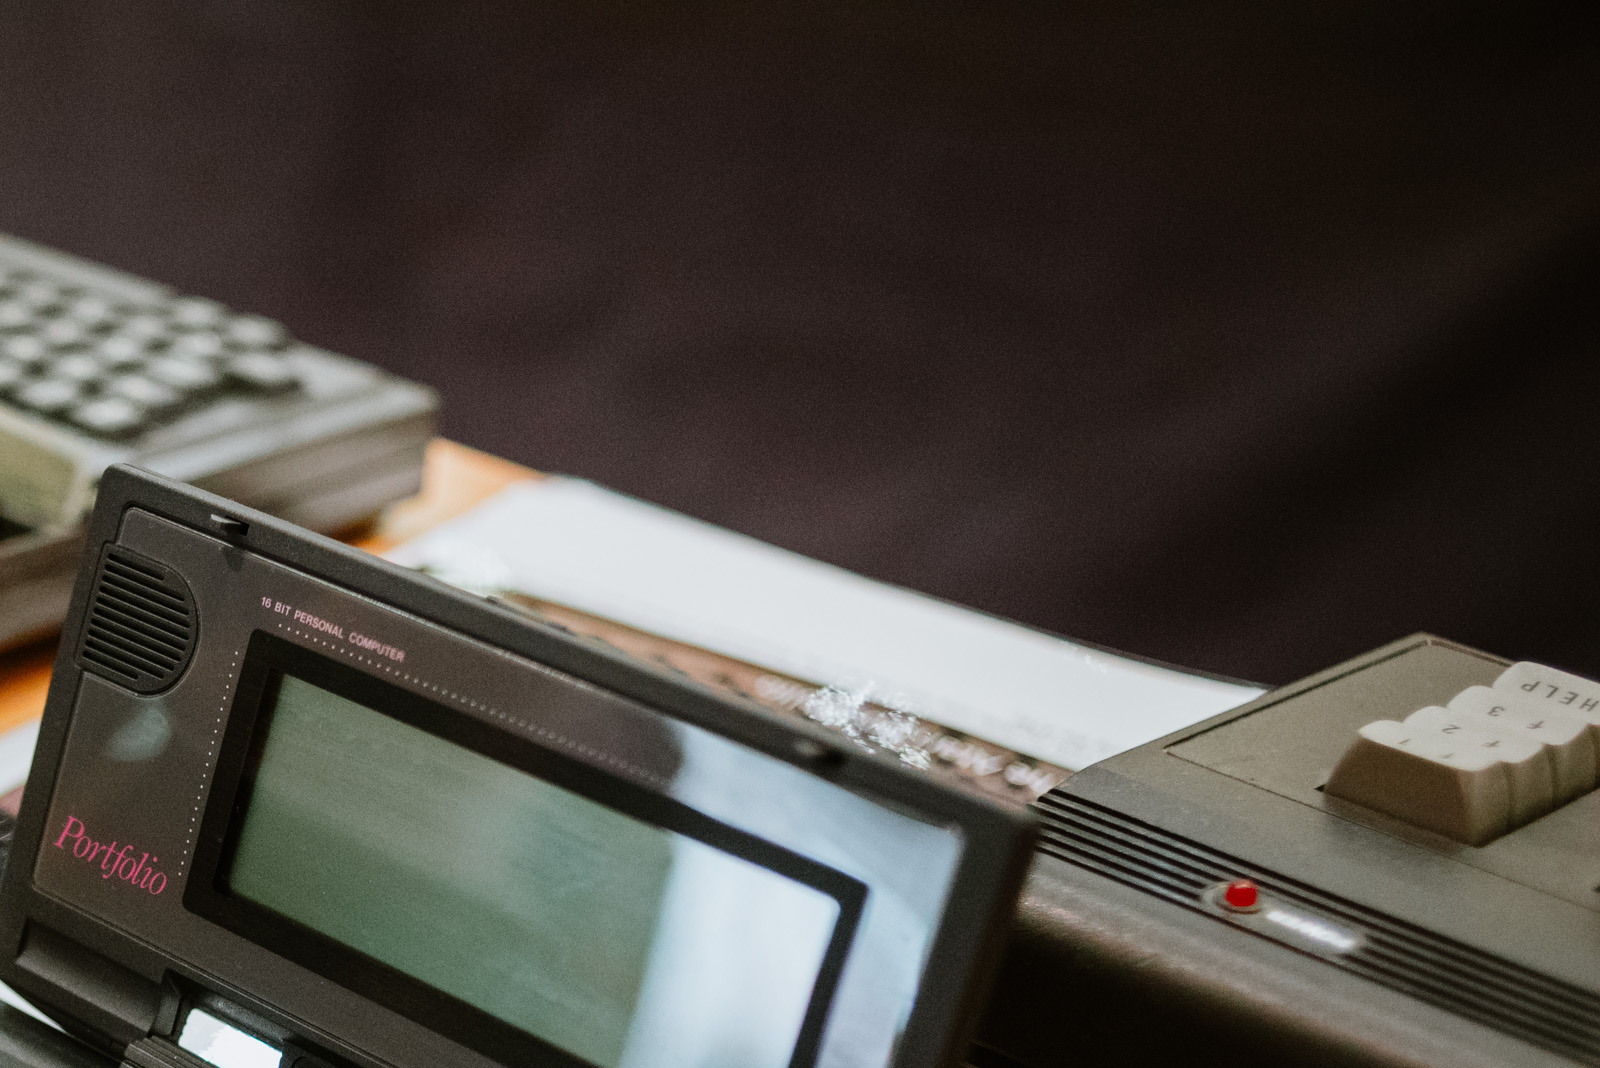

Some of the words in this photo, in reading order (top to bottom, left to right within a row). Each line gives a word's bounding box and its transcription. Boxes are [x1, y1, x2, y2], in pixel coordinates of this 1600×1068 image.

[261, 596, 272, 609] 16
[274, 601, 292, 616] BIT
[293, 609, 344, 639] PERSONAL
[348, 632, 406, 663] COMPUTER
[1488, 705, 1505, 717] 3
[1520, 680, 1600, 713] HELP
[54, 815, 167, 895] Portfolio
